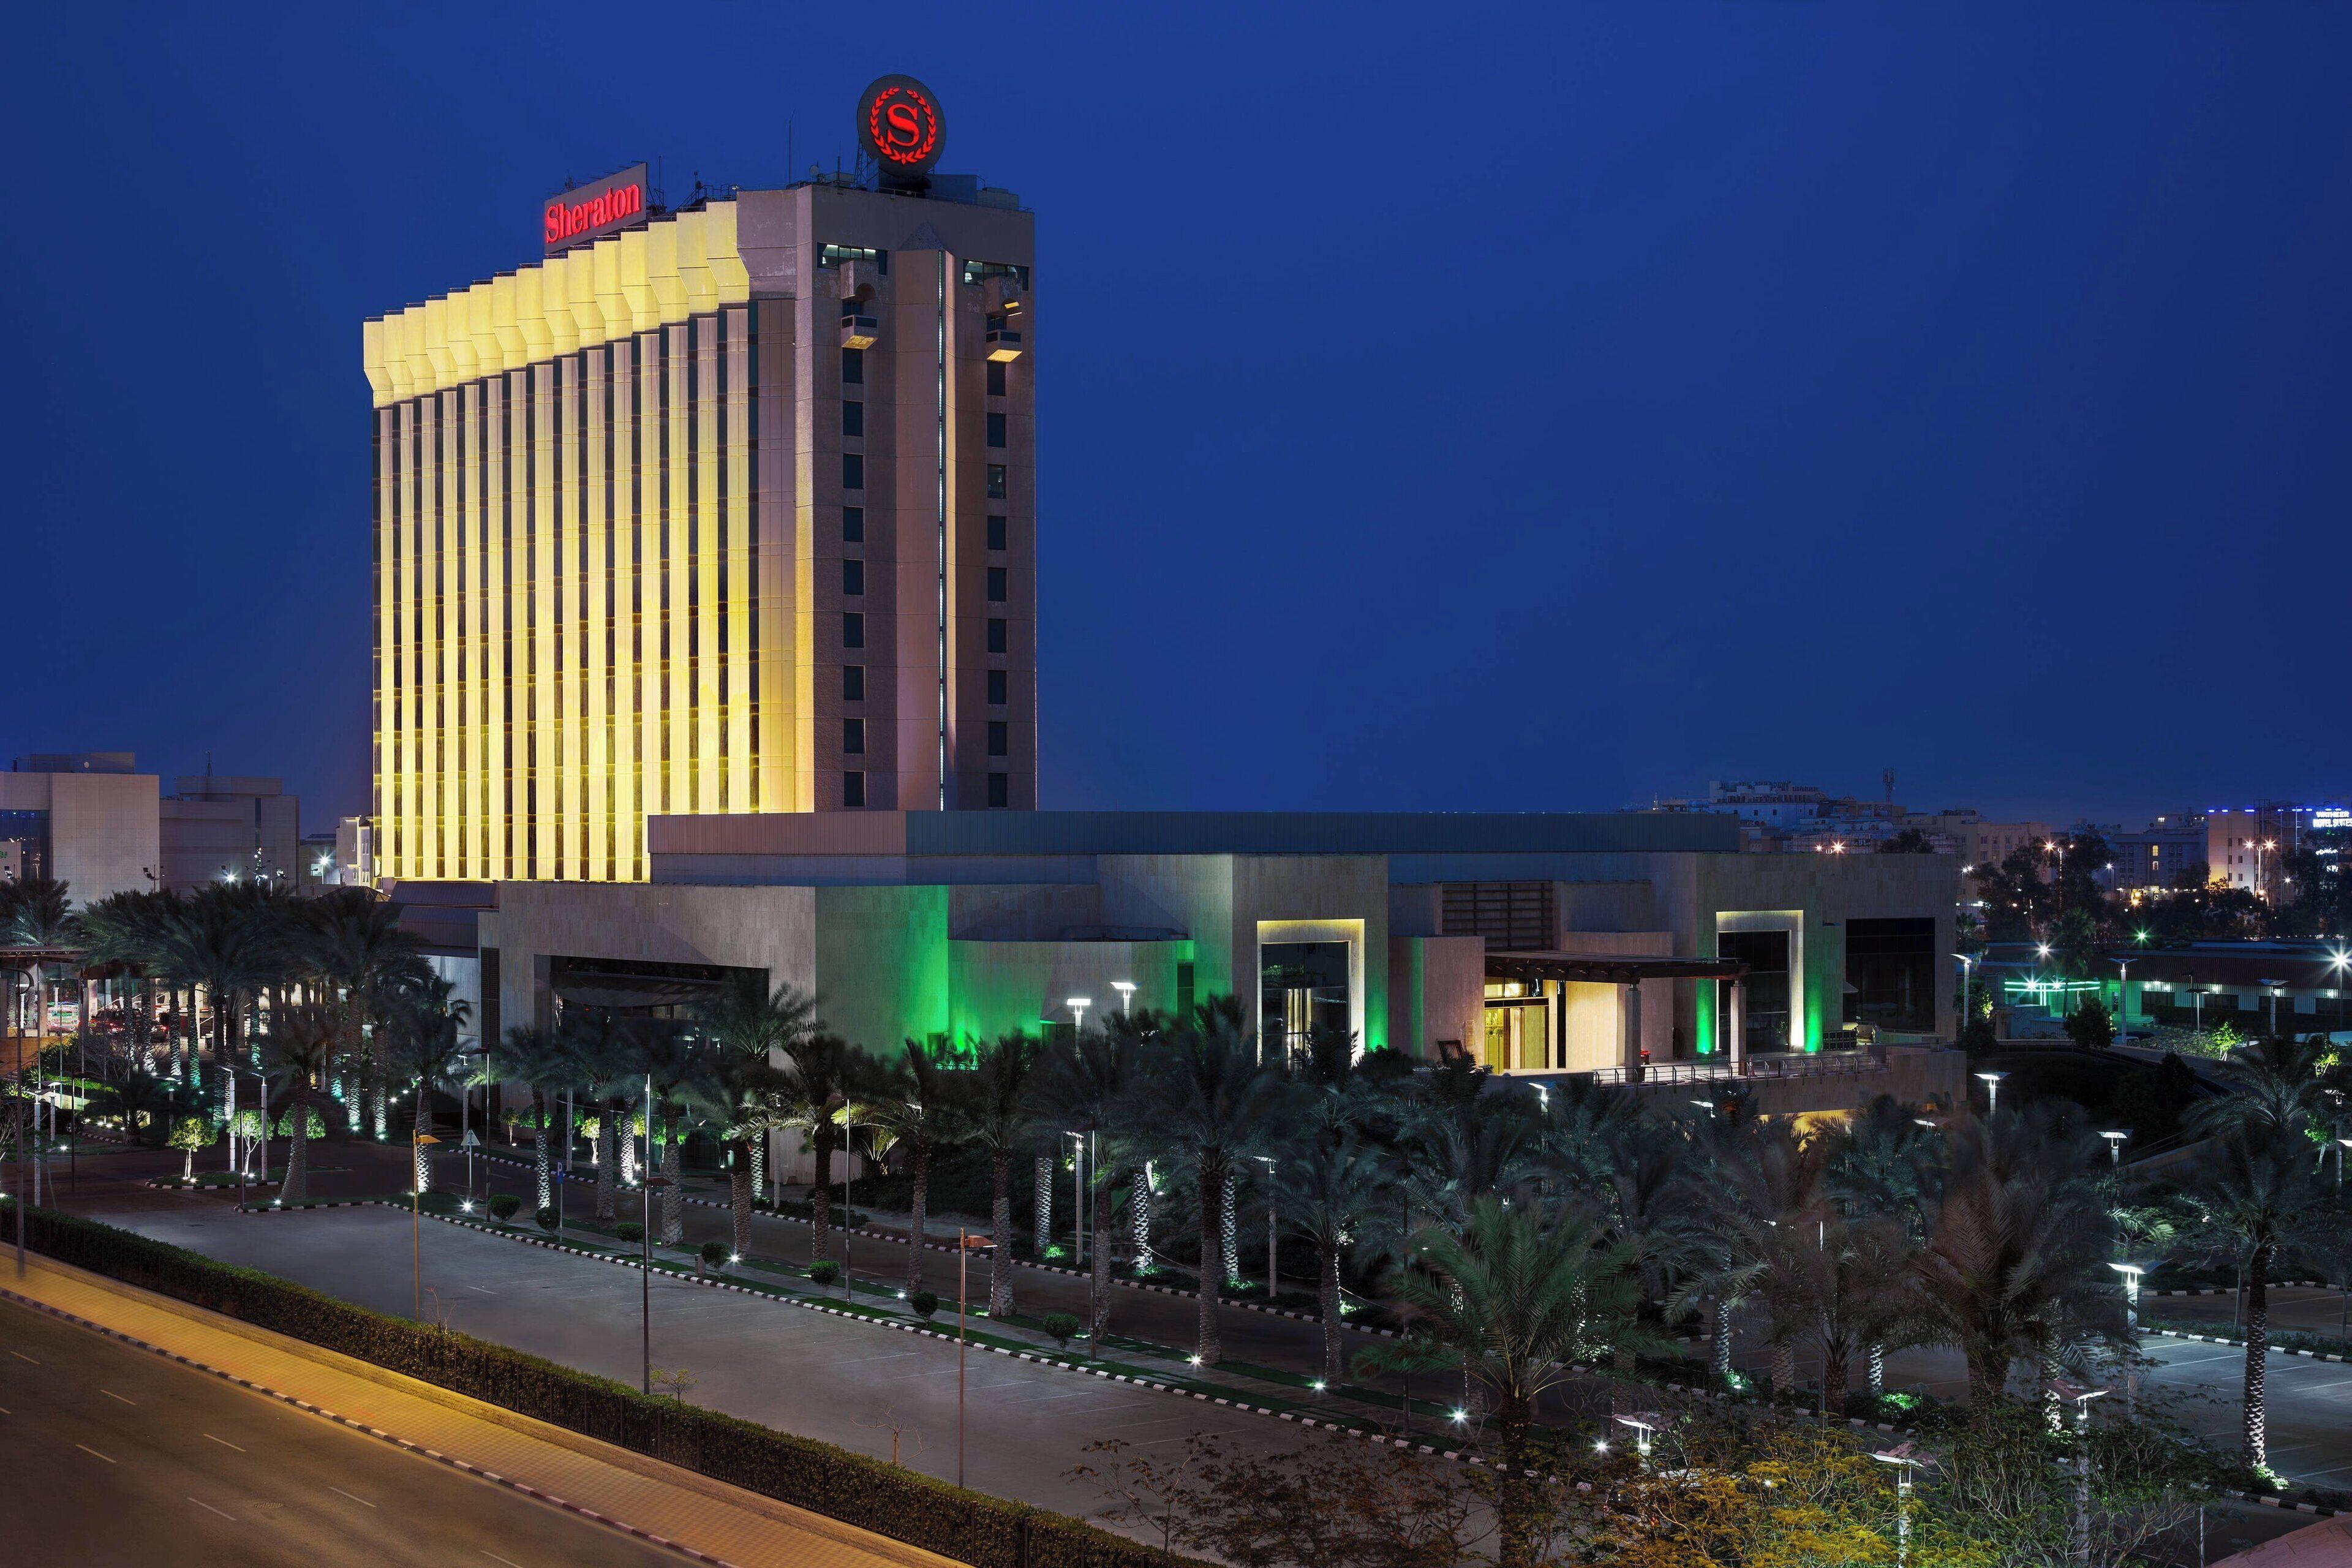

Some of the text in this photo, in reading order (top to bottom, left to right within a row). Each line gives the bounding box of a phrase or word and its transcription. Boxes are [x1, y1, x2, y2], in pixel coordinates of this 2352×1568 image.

[887, 104, 919, 146] S
[546, 184, 640, 243] Sheraton
[2313, 818, 2332, 827] HOTEL
[557, 1161, 563, 1176] P
